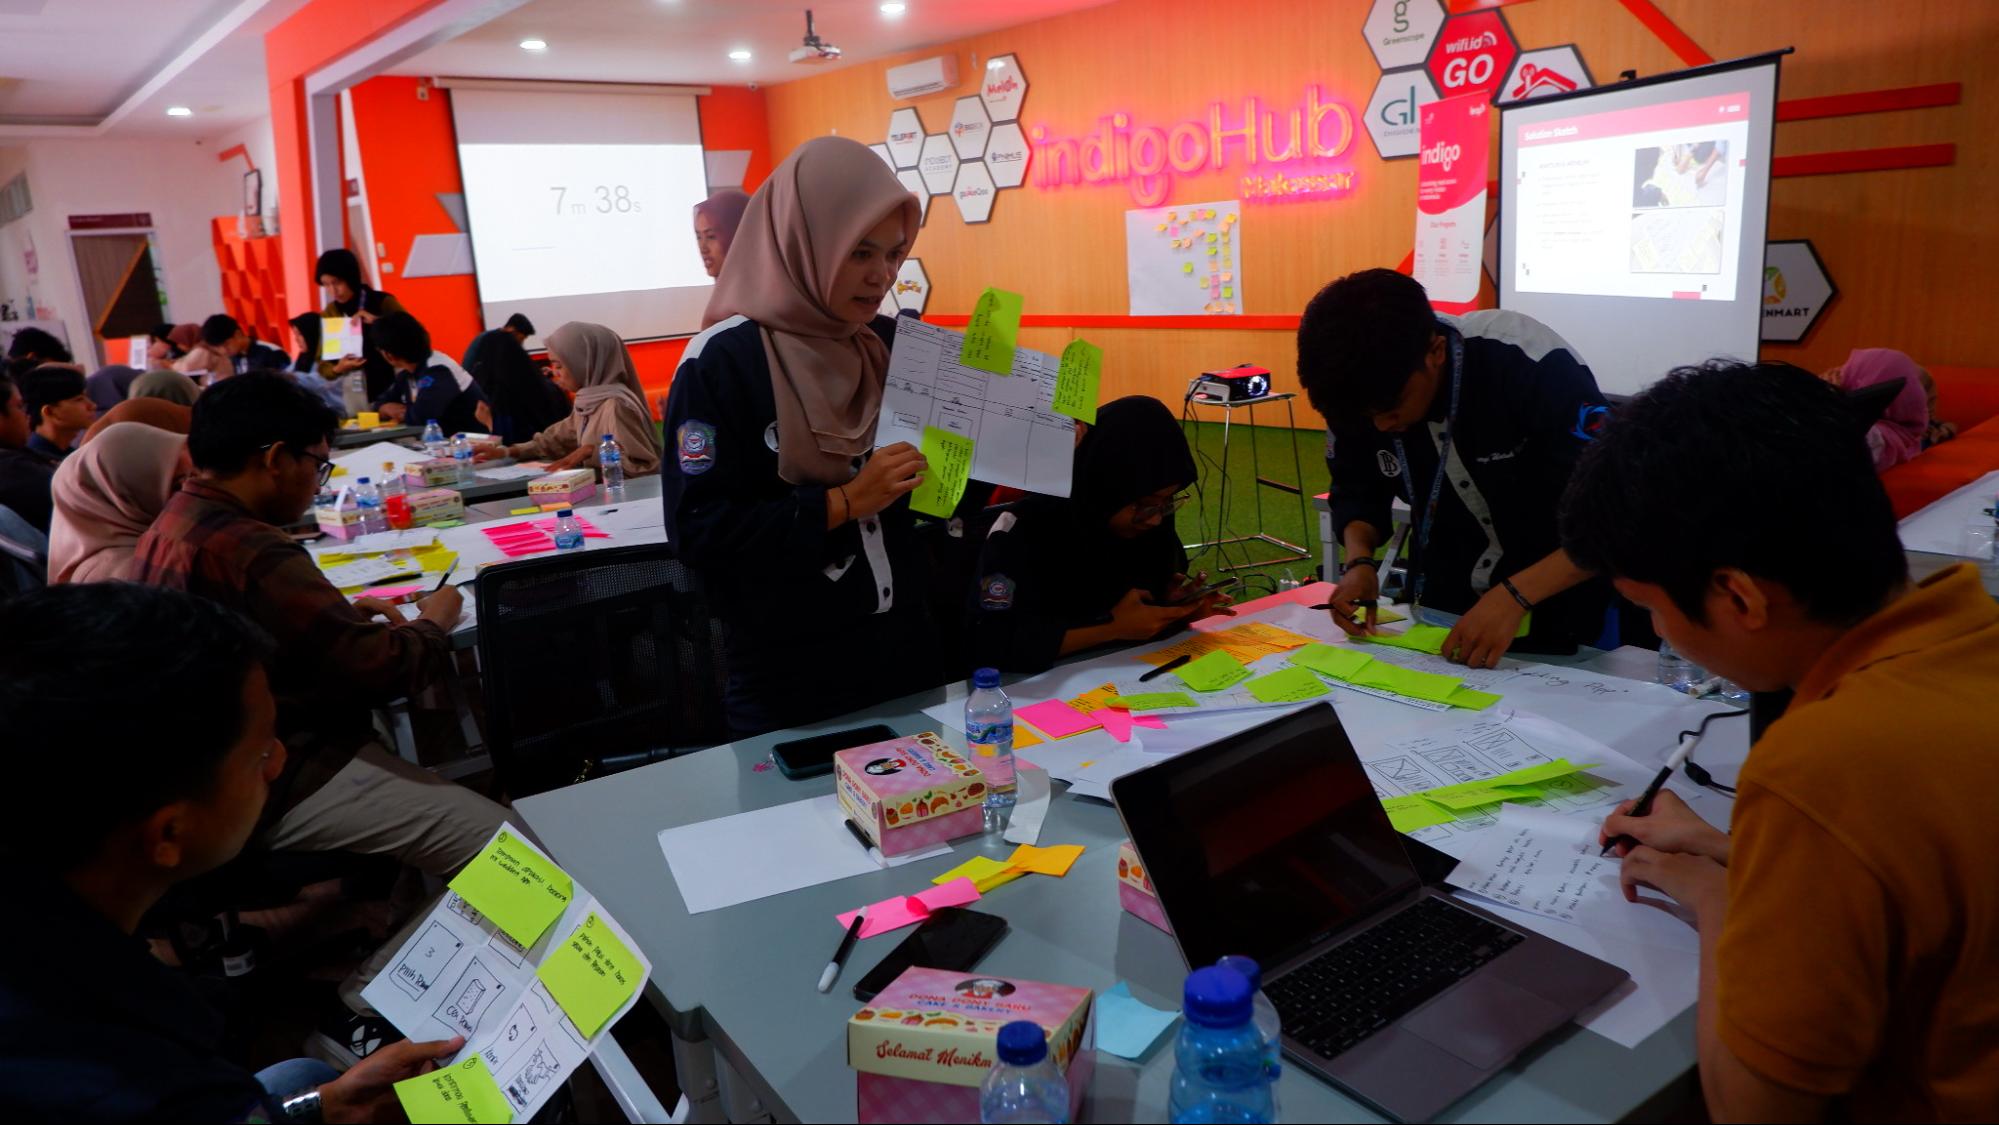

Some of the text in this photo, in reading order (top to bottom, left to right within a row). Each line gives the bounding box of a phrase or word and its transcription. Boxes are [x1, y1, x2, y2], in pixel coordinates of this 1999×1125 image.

[1442, 54, 1494, 88] GO
[1032, 85, 1354, 206] indigoHub
[1421, 141, 1461, 171] indigo
[1243, 171, 1355, 198] Makassar
[917, 1000, 946, 1008] CAKE
[876, 1040, 933, 1061] Selamat
